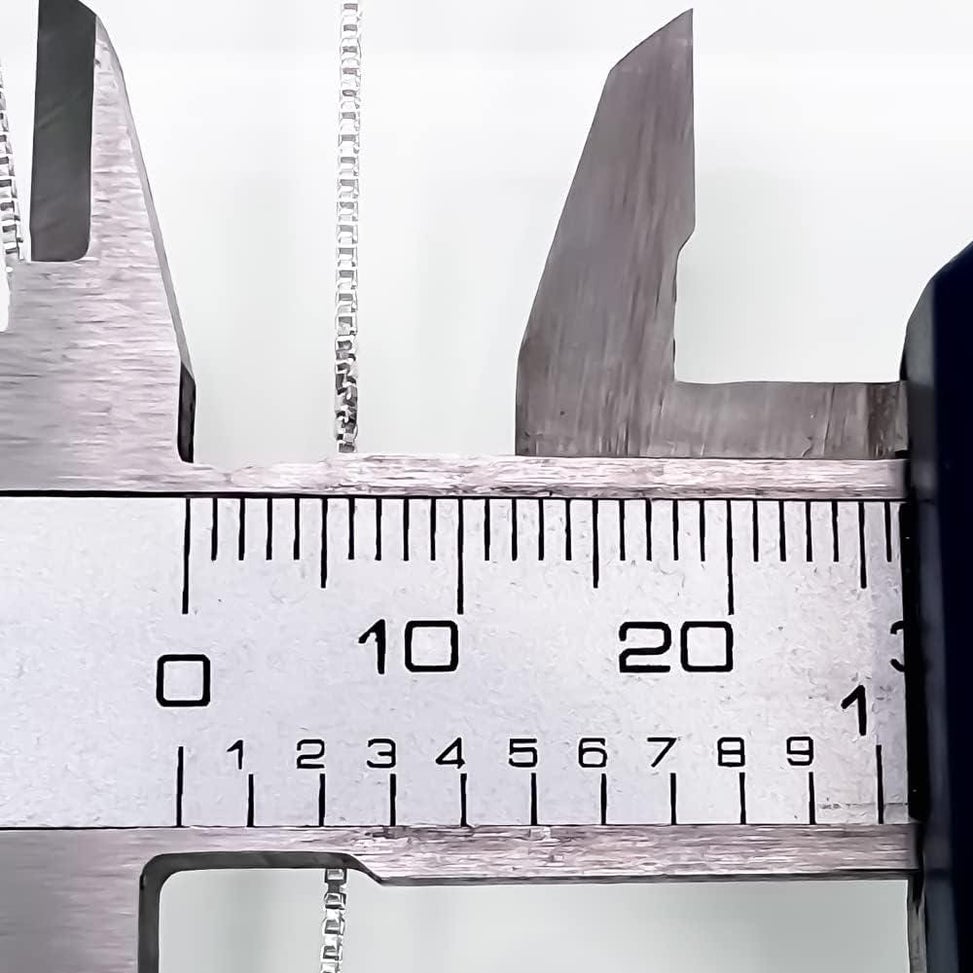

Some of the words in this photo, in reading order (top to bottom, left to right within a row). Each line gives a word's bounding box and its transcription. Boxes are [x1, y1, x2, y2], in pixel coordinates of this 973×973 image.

[155, 653, 211, 708] 0
[358, 618, 459, 675] 10
[618, 620, 734, 674] 20
[840, 684, 868, 737] 1
[226, 739, 244, 770] 1
[296, 738, 326, 770] 2
[366, 738, 397, 769] 3
[435, 737, 466, 770] 4
[508, 738, 538, 768] 5
[578, 737, 608, 768] 6
[646, 736, 677, 768] 7
[716, 736, 746, 768] 8
[786, 736, 814, 767] 9
